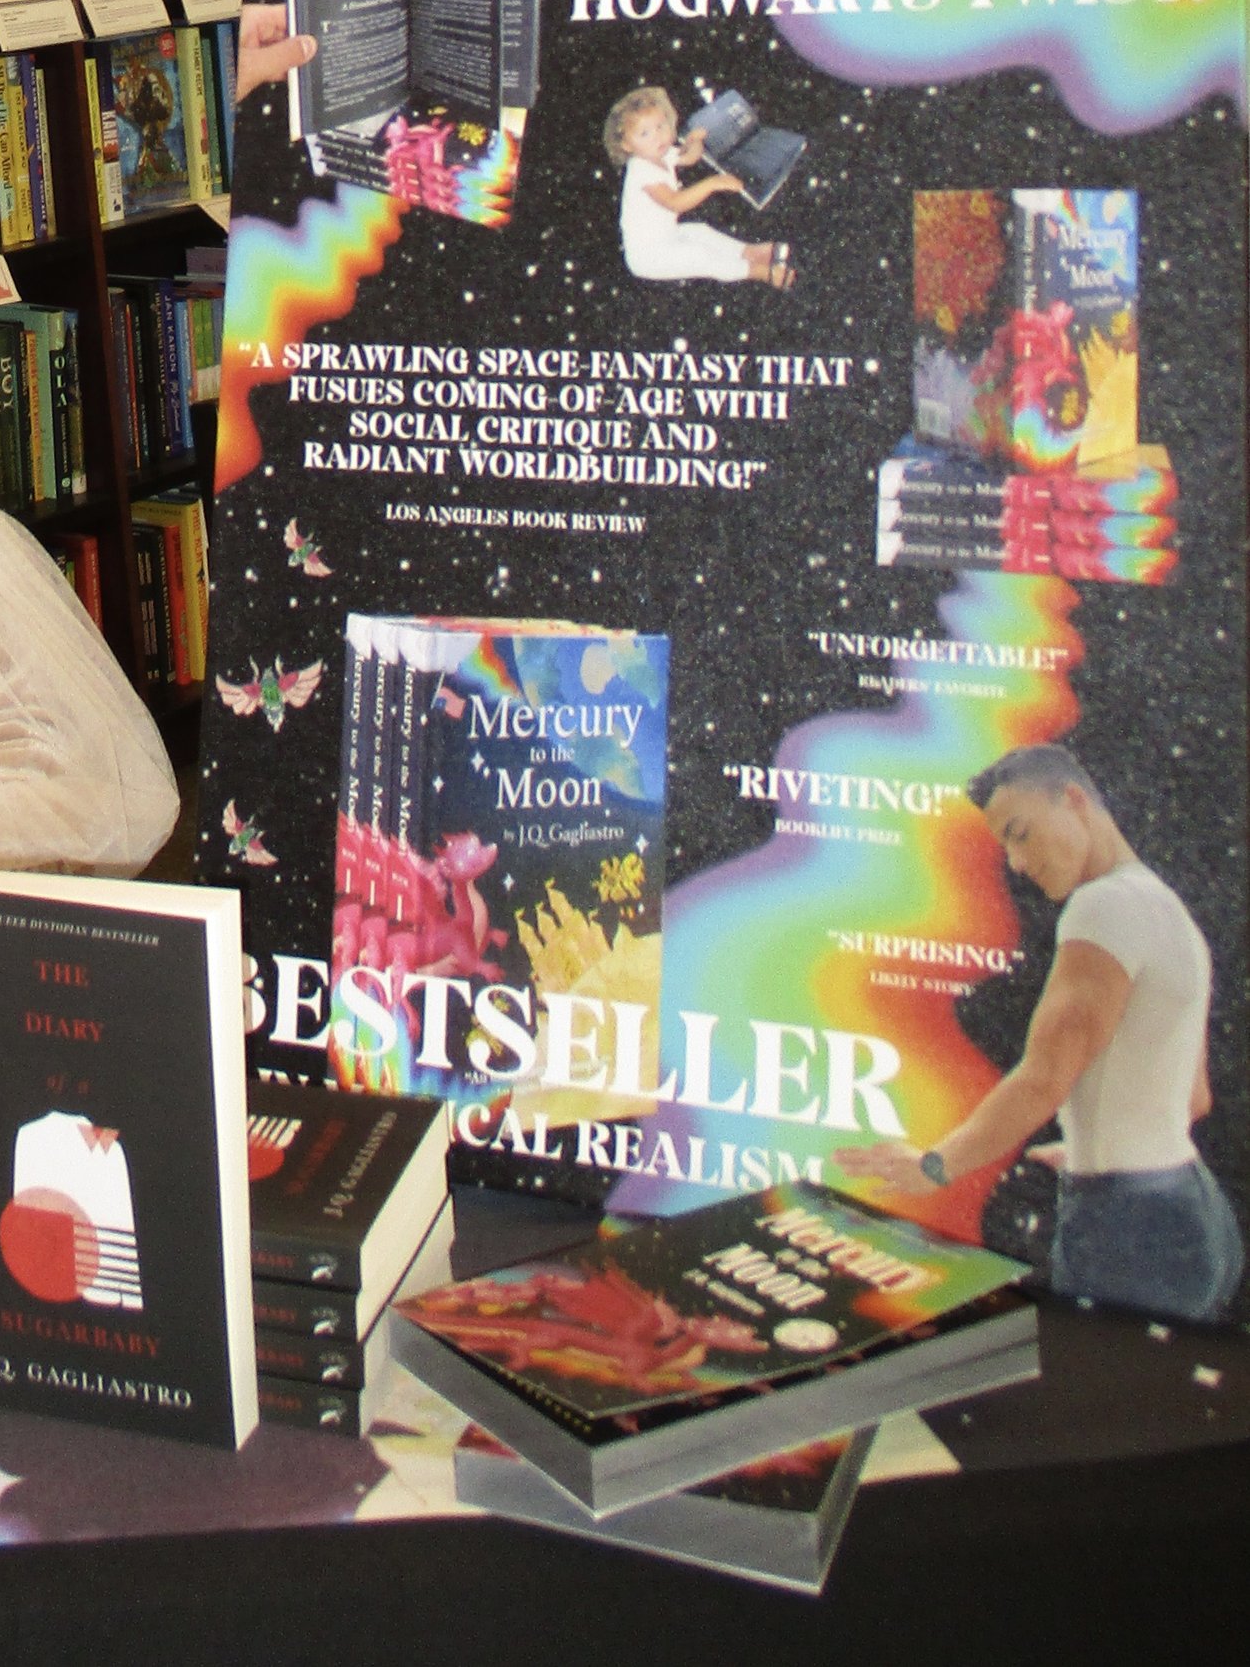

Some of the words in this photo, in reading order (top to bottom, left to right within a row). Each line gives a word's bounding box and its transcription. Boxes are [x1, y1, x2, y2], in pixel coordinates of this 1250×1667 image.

[164, 295, 174, 327] JAN
[167, 331, 177, 372] KARON
[282, 343, 470, 374] SPRAWLING
[477, 347, 747, 384] SPACE-FANTASY
[756, 354, 852, 386] THAT
[414, 378, 685, 417] COMING-OF-AGE
[694, 387, 789, 420] WITH
[349, 411, 470, 443] SOCIAL
[476, 415, 633, 450] CRITIQUE
[641, 421, 718, 452] AND
[303, 441, 450, 474] RADIANT
[385, 503, 422, 522] LOS
[426, 505, 509, 526] ANGELES
[512, 509, 568, 530] BOOK
[572, 512, 647, 533] REVIEW
[468, 694, 644, 748] Mercury
[530, 746, 547, 763] to
[550, 746, 576, 763] the
[495, 767, 602, 811] Moon
[549, 823, 625, 844] Gagliastro
[857, 825, 903, 845] PRIZE
[91, 927, 160, 946] BESTSELLER
[34, 960, 91, 988] THE
[24, 1012, 104, 1043] DIARY
[0, 1310, 160, 1359] SUGARBABY
[28, 1361, 193, 1409] GAGLIASTRO
